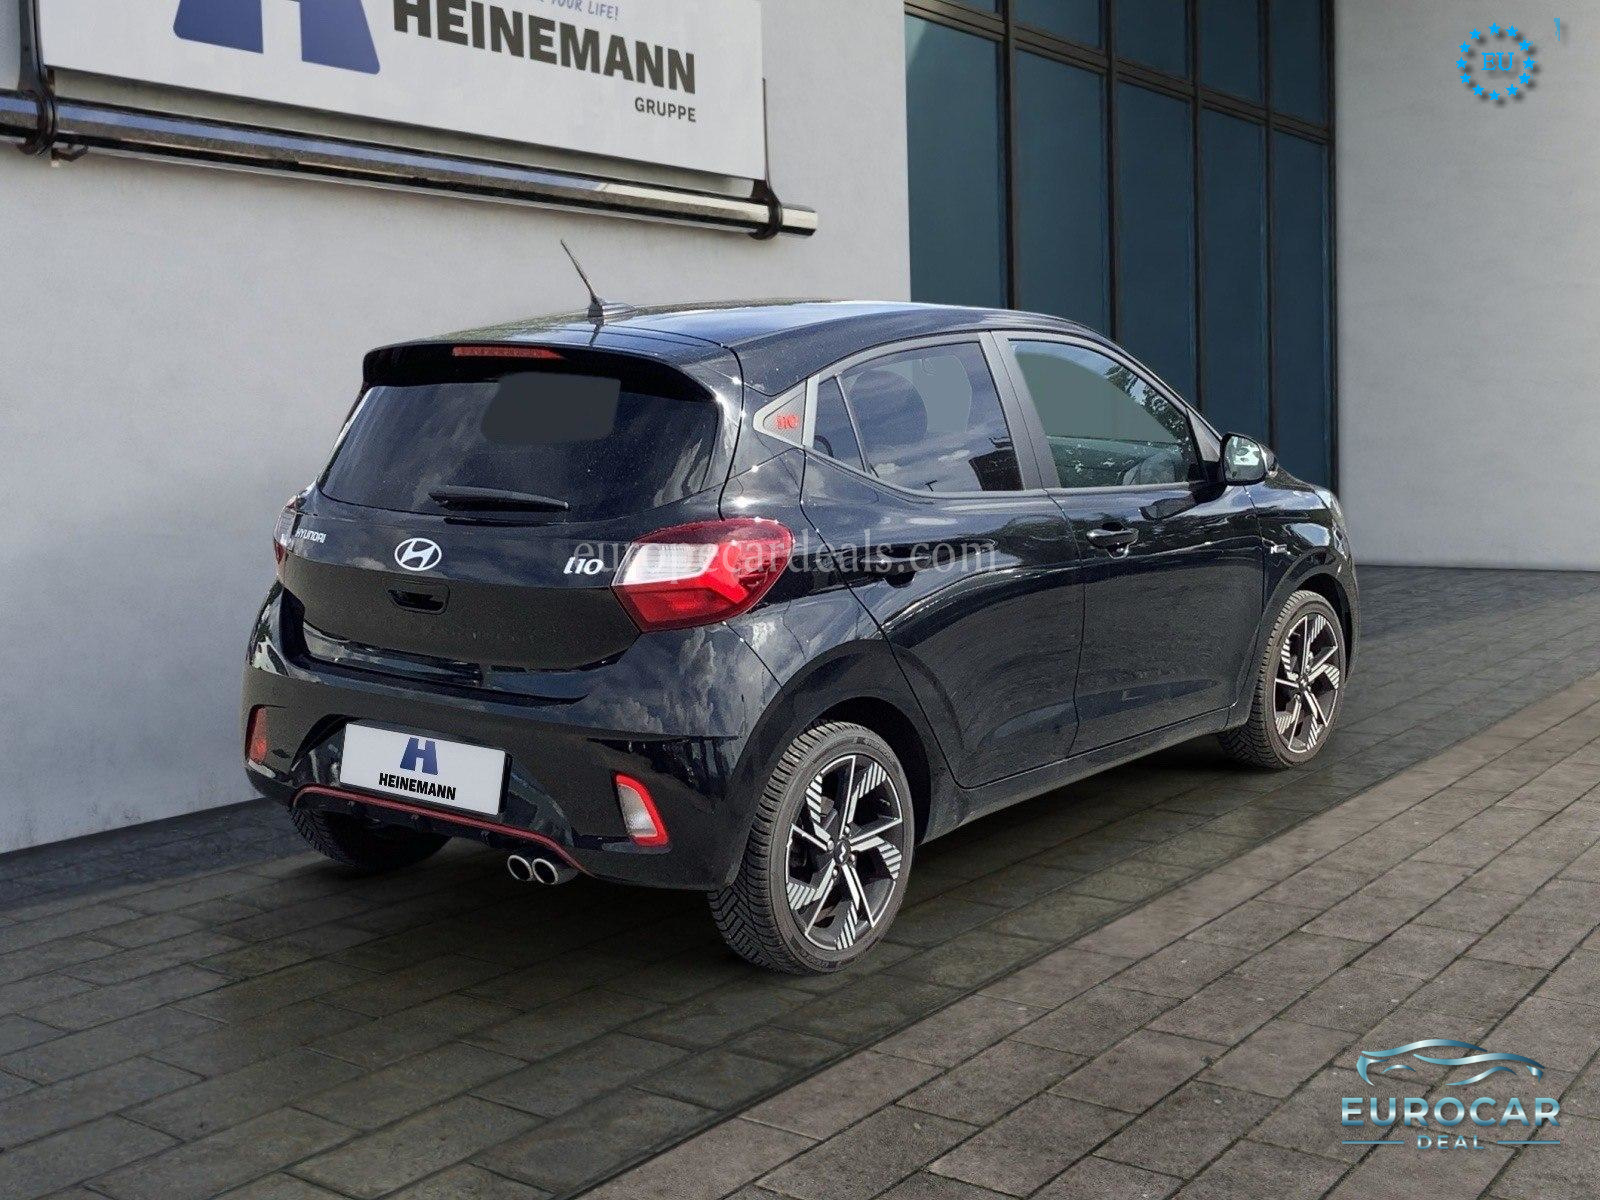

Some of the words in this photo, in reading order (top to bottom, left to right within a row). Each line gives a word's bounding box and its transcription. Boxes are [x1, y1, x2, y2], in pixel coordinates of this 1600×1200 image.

[588, 2, 619, 21] LIFE!
[393, 0, 696, 94] HEINEMANN
[634, 96, 697, 122] GRUPPE
[379, 772, 456, 801] HEINEMANN
